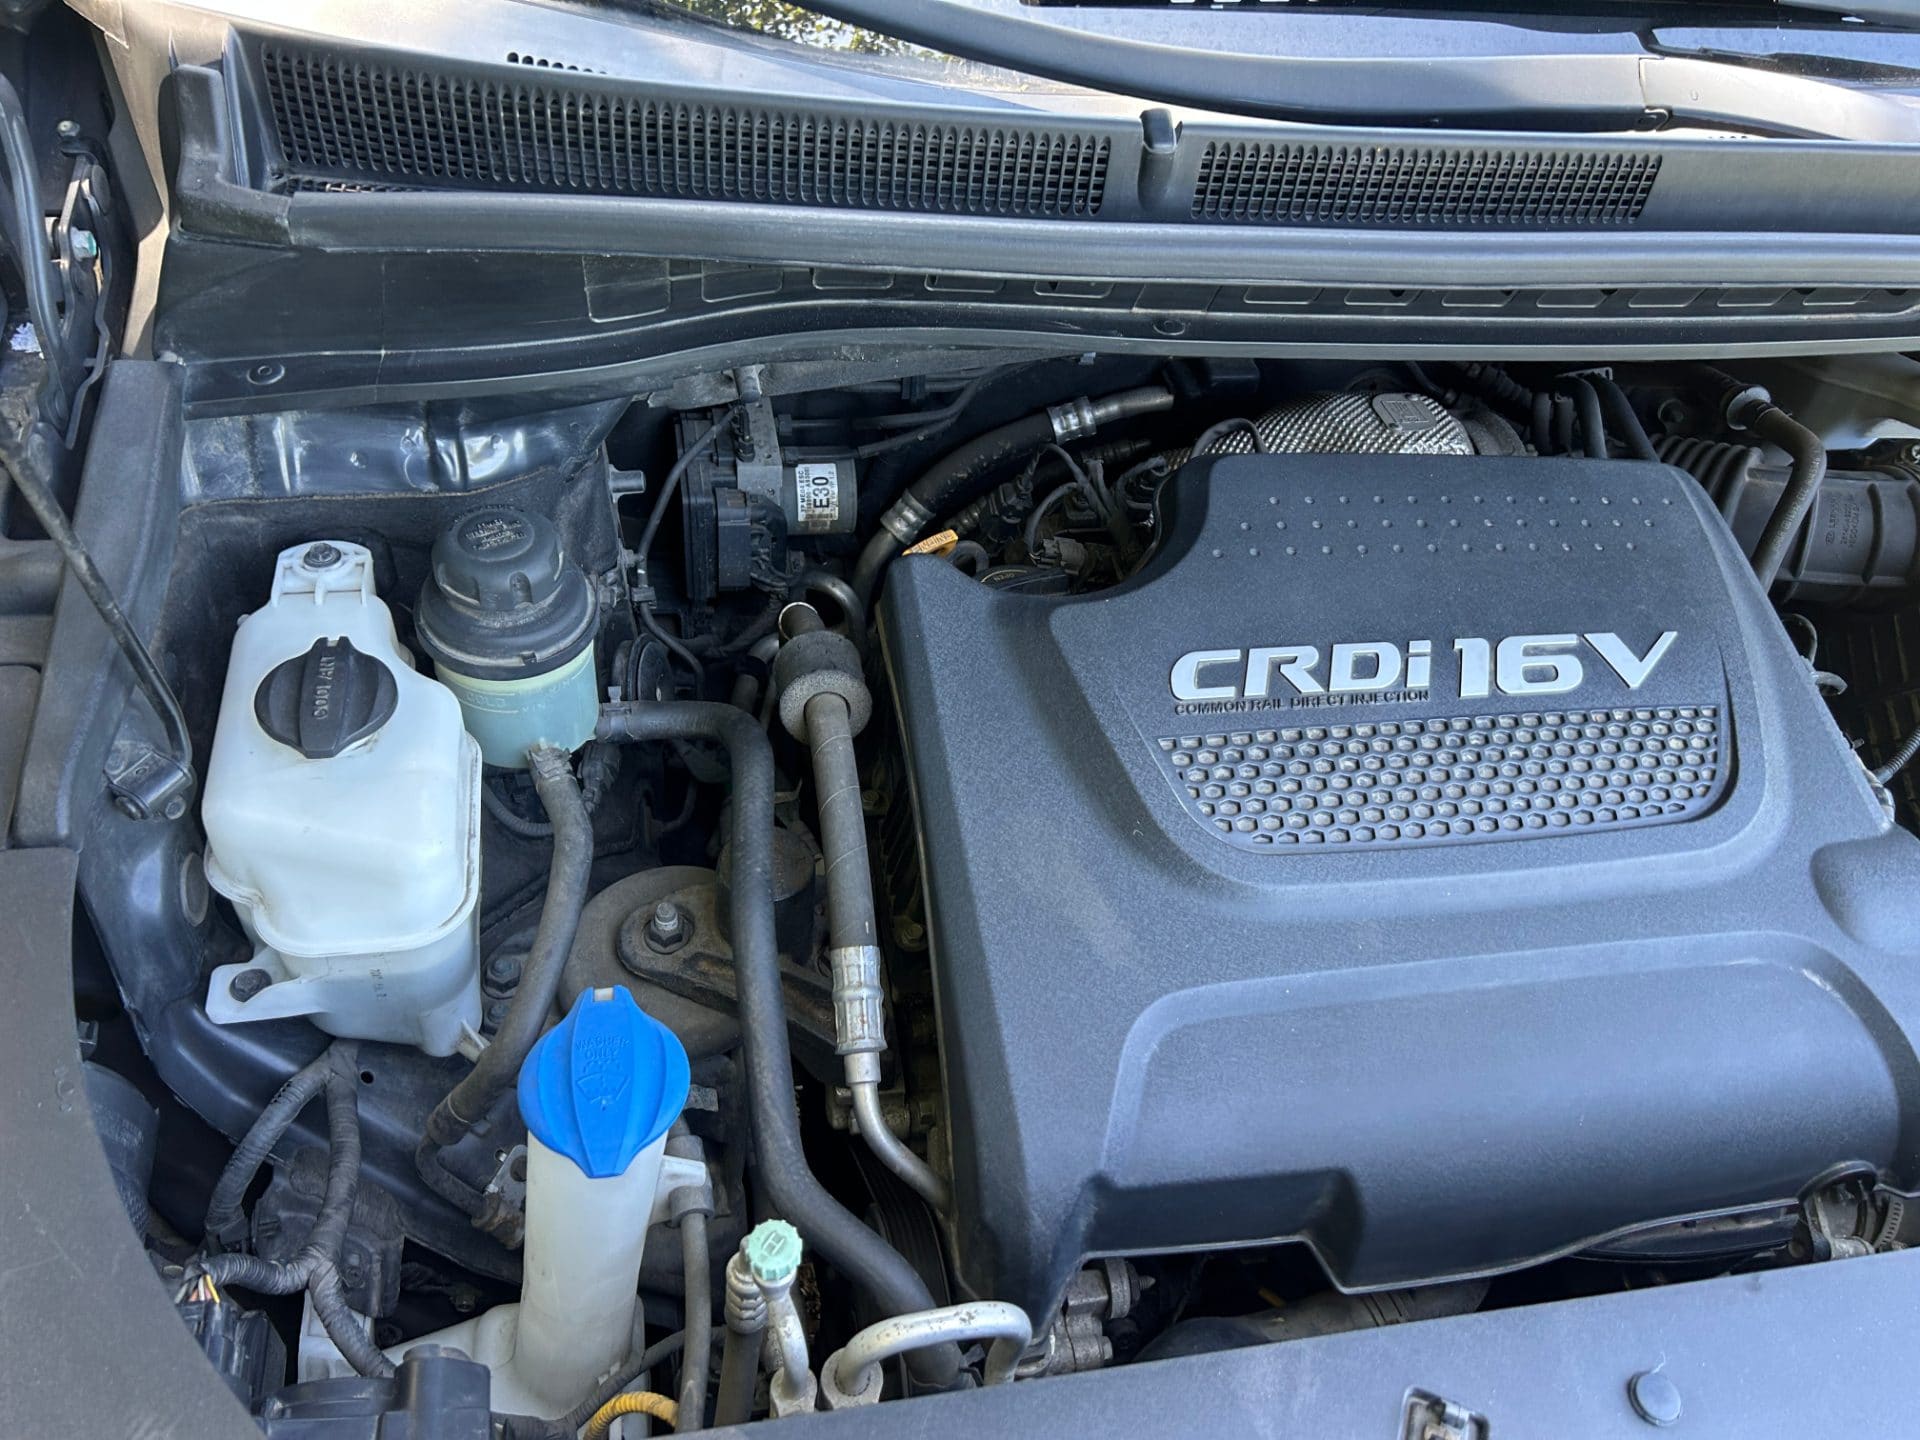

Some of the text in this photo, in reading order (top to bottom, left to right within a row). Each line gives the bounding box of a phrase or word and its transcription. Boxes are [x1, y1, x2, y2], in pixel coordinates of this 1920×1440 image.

[811, 476, 830, 508] E30
[1169, 630, 1678, 700] CRDi 16V
[313, 656, 335, 720] COOLANT
[1174, 690, 1430, 715] COMMON RAIL DIRECT INJECTION
[761, 1231, 787, 1256] H
